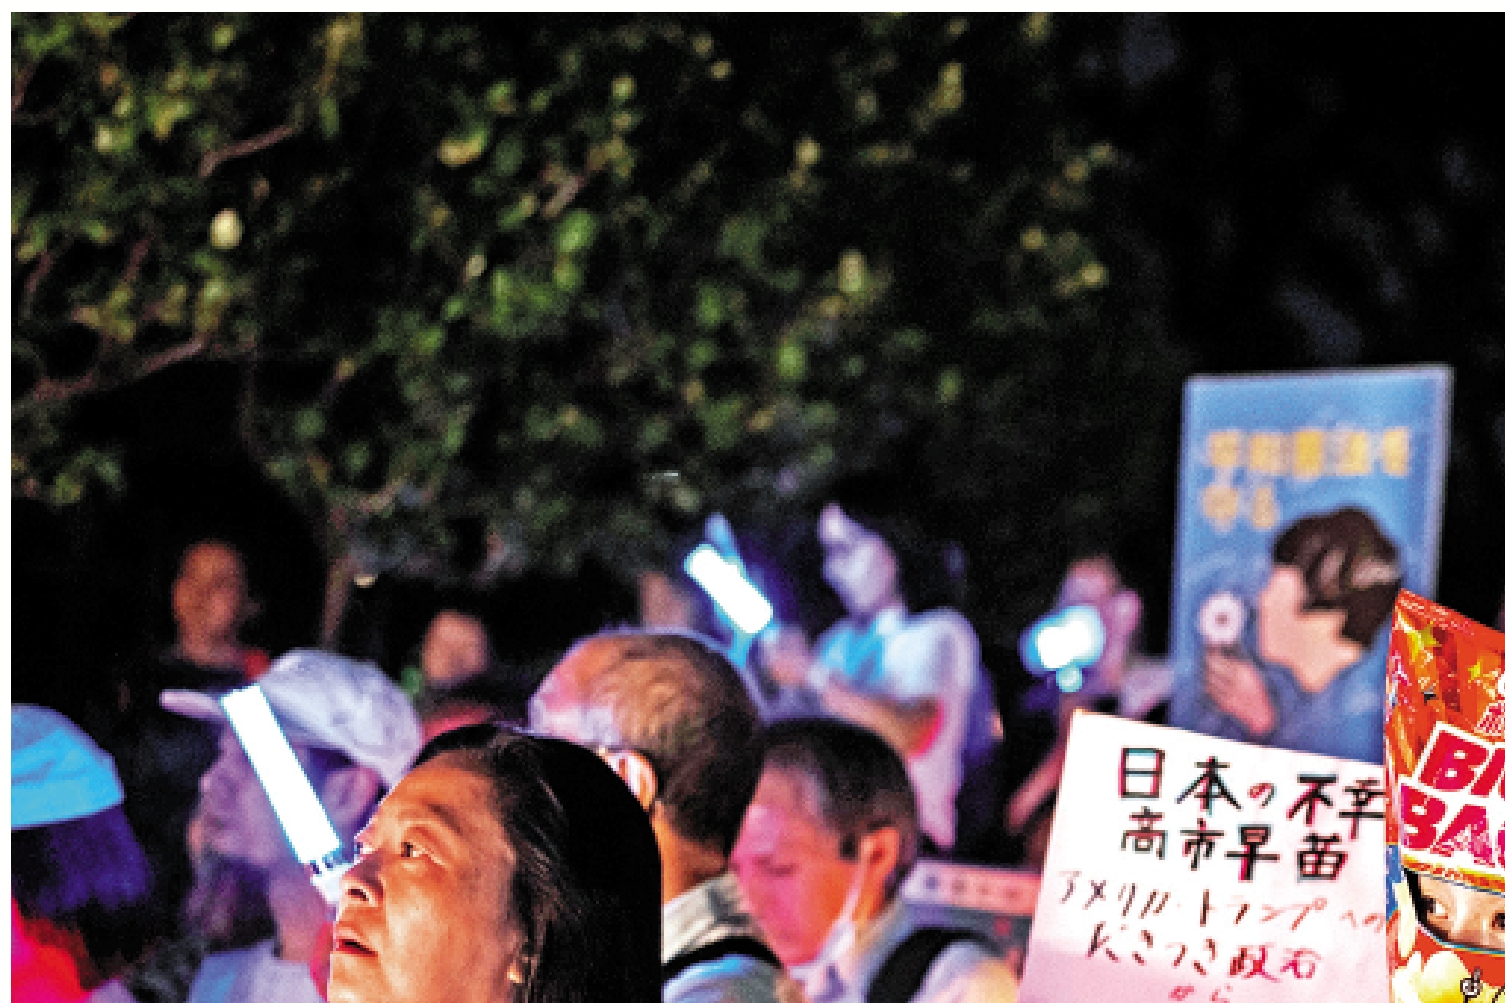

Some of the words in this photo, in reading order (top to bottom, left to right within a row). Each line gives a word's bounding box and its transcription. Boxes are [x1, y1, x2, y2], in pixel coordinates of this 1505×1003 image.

[1118, 747, 1387, 840] 日本の不幸
[1121, 806, 1351, 884] 高市早苗
